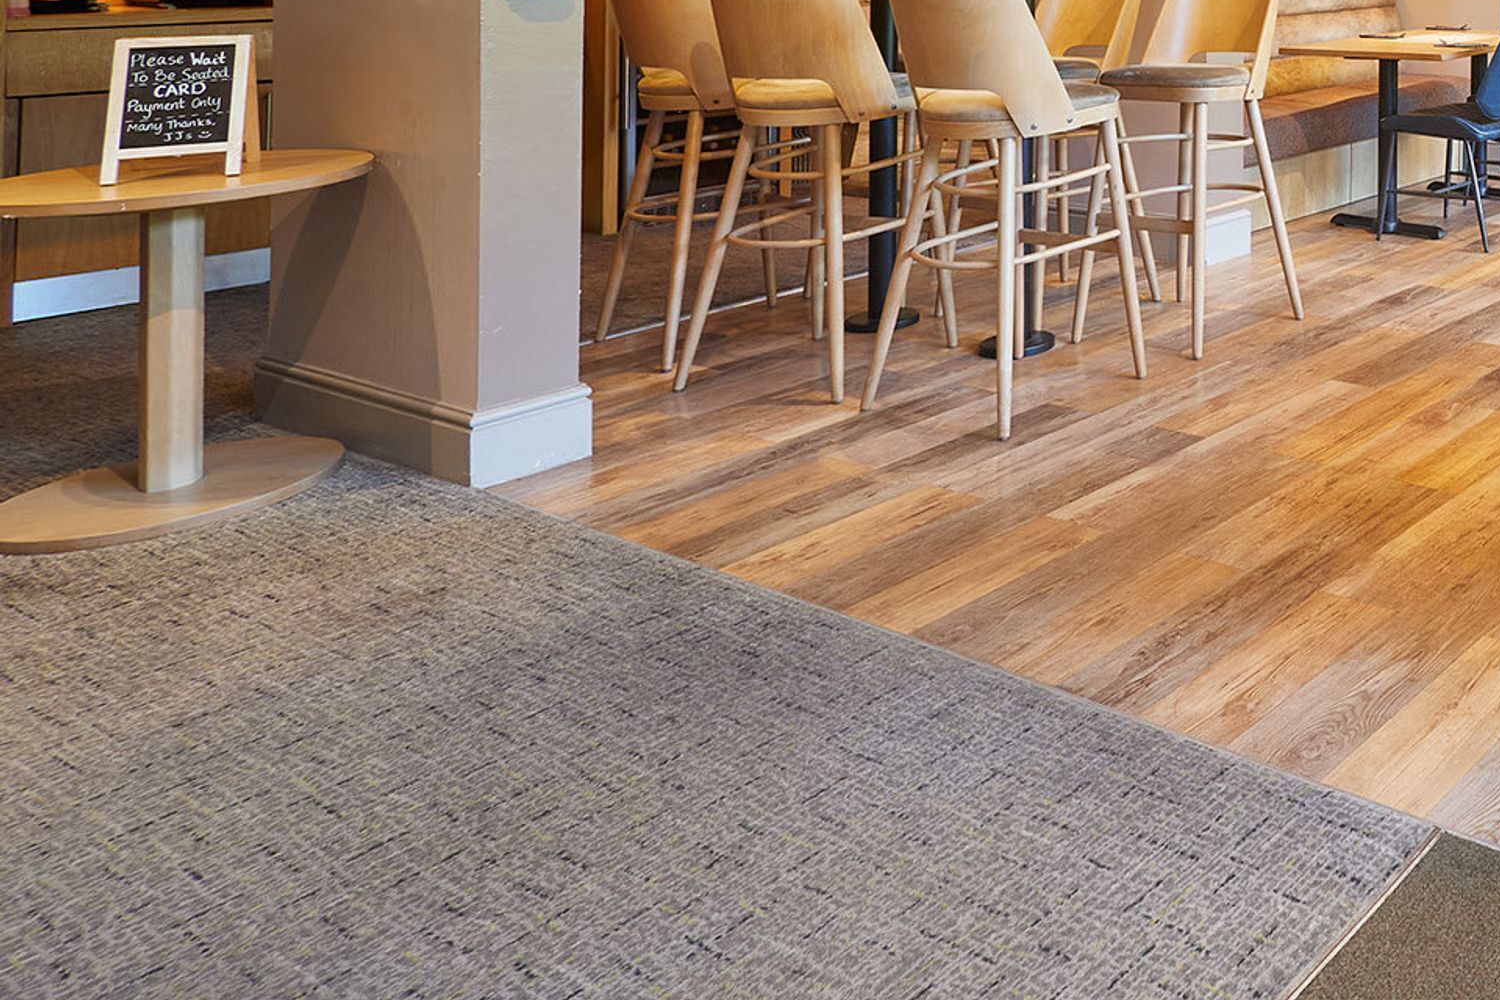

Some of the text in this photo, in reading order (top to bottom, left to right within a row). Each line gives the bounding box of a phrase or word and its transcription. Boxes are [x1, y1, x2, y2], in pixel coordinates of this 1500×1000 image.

[131, 52, 226, 68] Please Wait
[132, 67, 229, 83] To Be Seated
[153, 82, 207, 98] CARD
[127, 96, 222, 119] Payment Only
